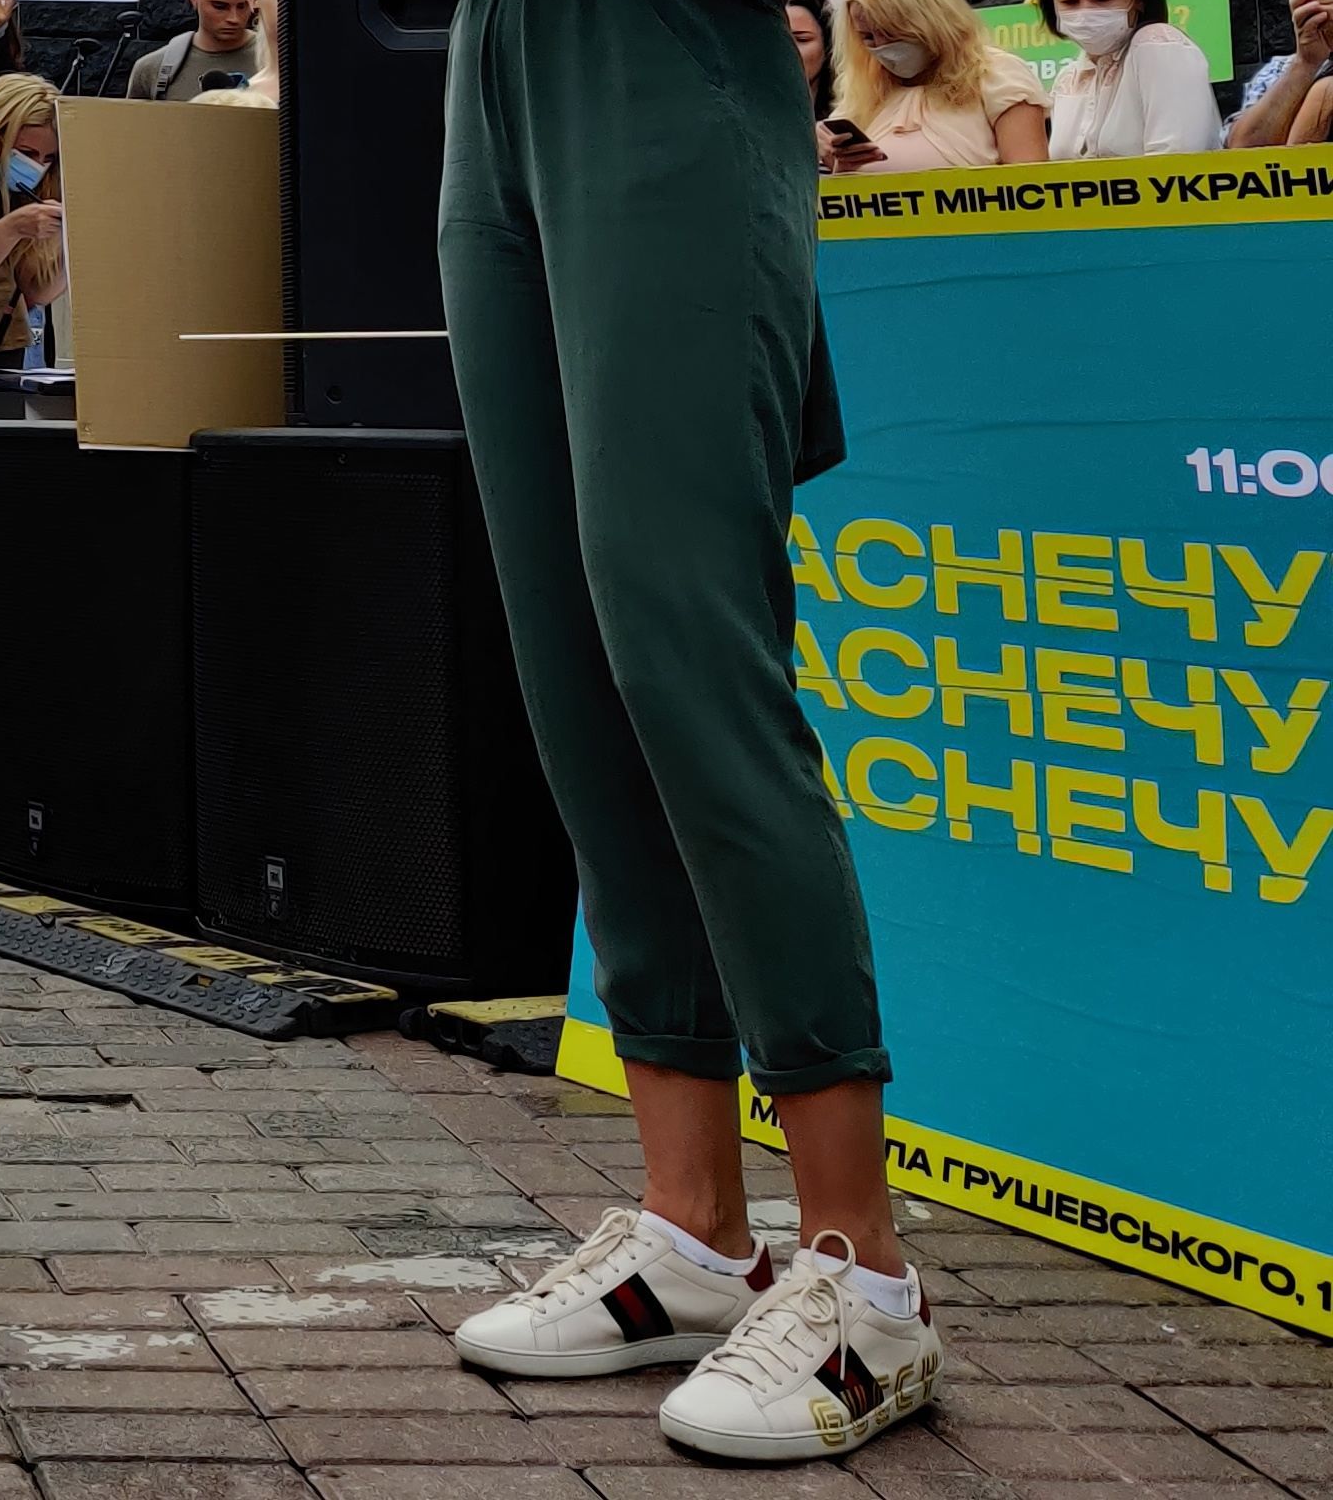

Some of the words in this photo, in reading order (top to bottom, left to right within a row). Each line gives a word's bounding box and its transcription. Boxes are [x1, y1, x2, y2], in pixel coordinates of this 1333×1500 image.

[818, 190, 925, 220] БІНЕТ
[935, 177, 1141, 215] МІНІСТРІВ
[1186, 447, 1333, 498] 11:0
[786, 514, 1327, 648] АСНЕЧУ
[795, 619, 1330, 774] АСНЕЧУ
[942, 1156, 1305, 1307] ГРУШЕВСЬКОГО,
